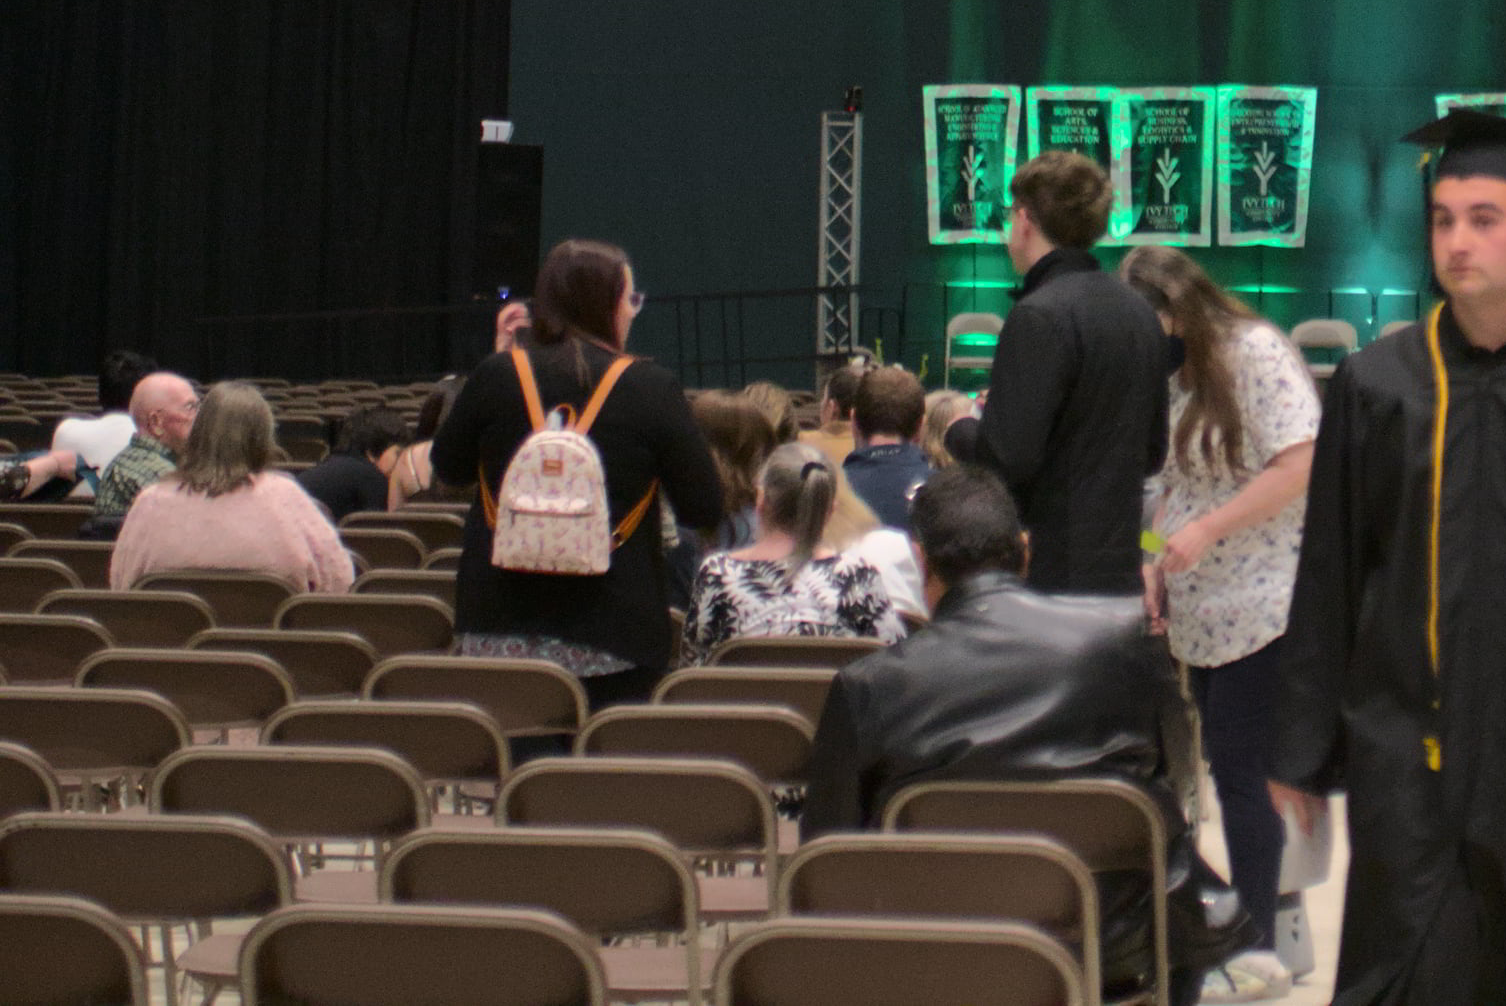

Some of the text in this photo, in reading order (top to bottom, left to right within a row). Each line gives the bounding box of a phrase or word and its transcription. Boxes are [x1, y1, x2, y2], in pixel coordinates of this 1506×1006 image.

[1053, 107, 1098, 116] SCHOOL OF
[1145, 107, 1189, 116] SCHOOL OF
[1142, 126, 1184, 135] LOGISTICS
[1051, 134, 1100, 144] EDUCATION
[1138, 134, 1197, 144] SUPPLY CHAIN
[1243, 197, 1285, 210] IVY TECH
[1146, 205, 1162, 216] IVY
